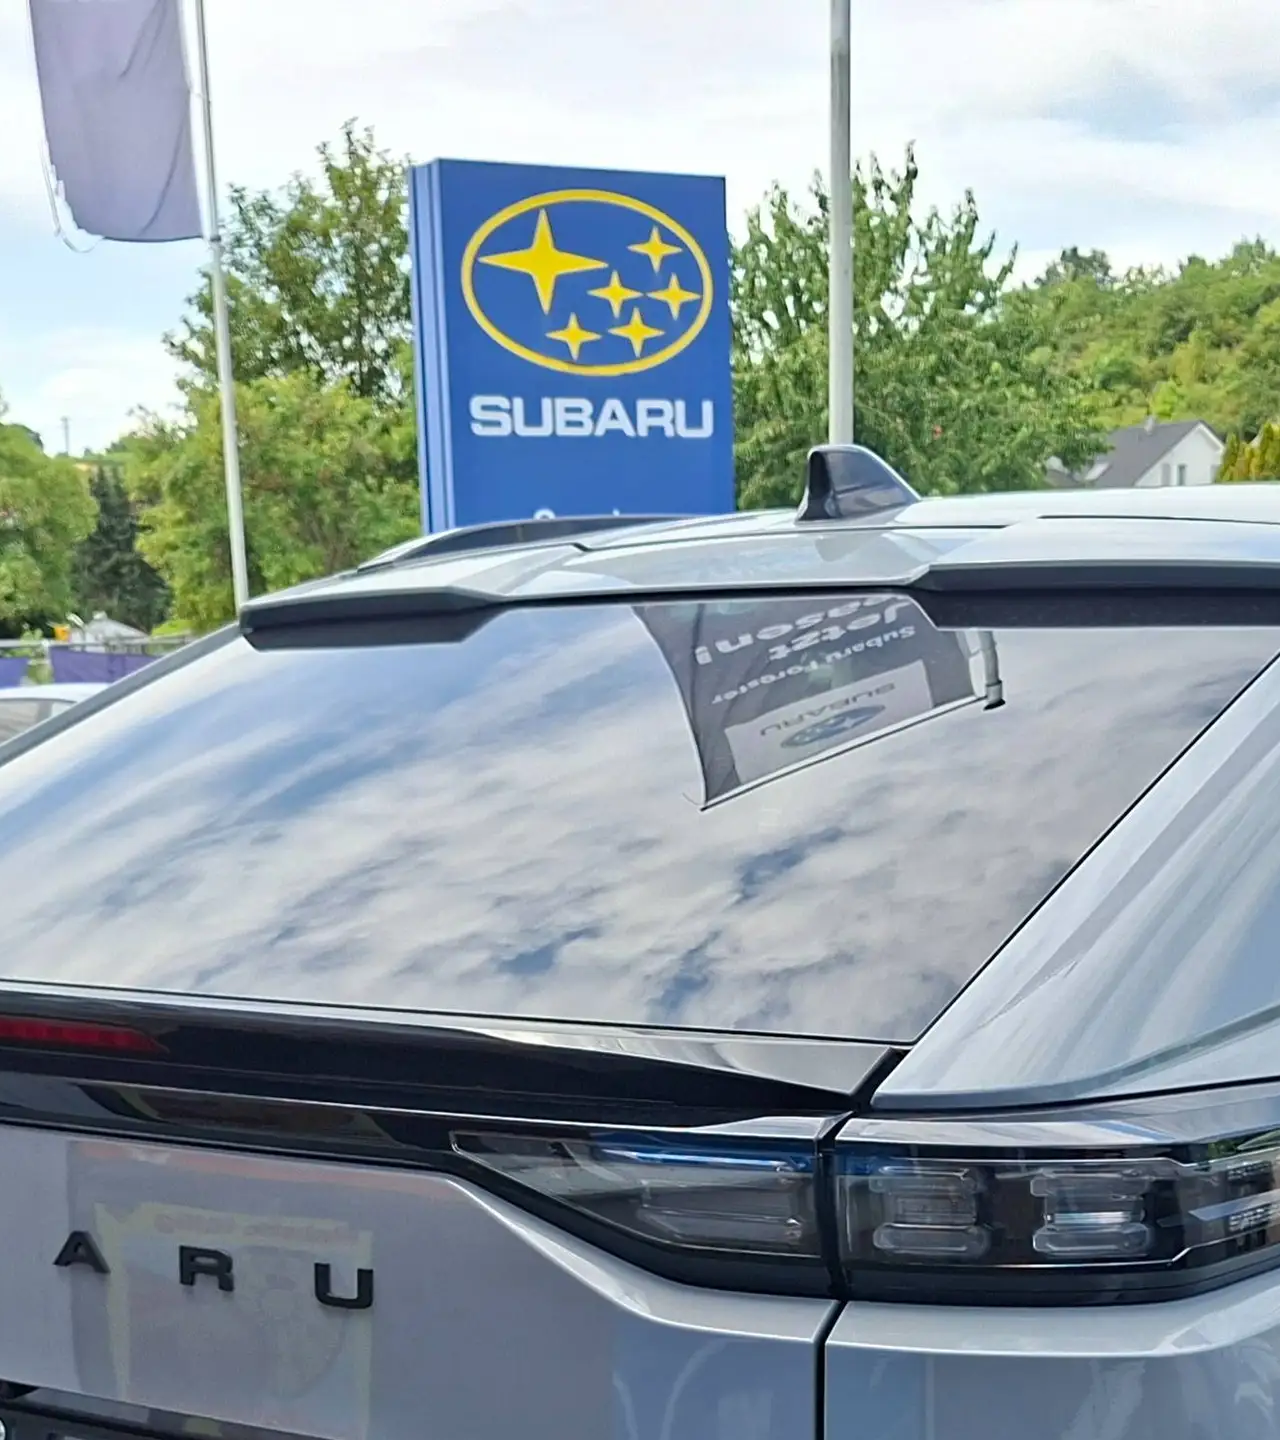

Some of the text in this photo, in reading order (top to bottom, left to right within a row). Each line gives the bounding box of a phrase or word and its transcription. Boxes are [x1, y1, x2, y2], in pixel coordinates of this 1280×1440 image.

[469, 394, 715, 438] SUBARU
[825, 625, 916, 664] Subaru
[760, 682, 895, 737] SUBARU
